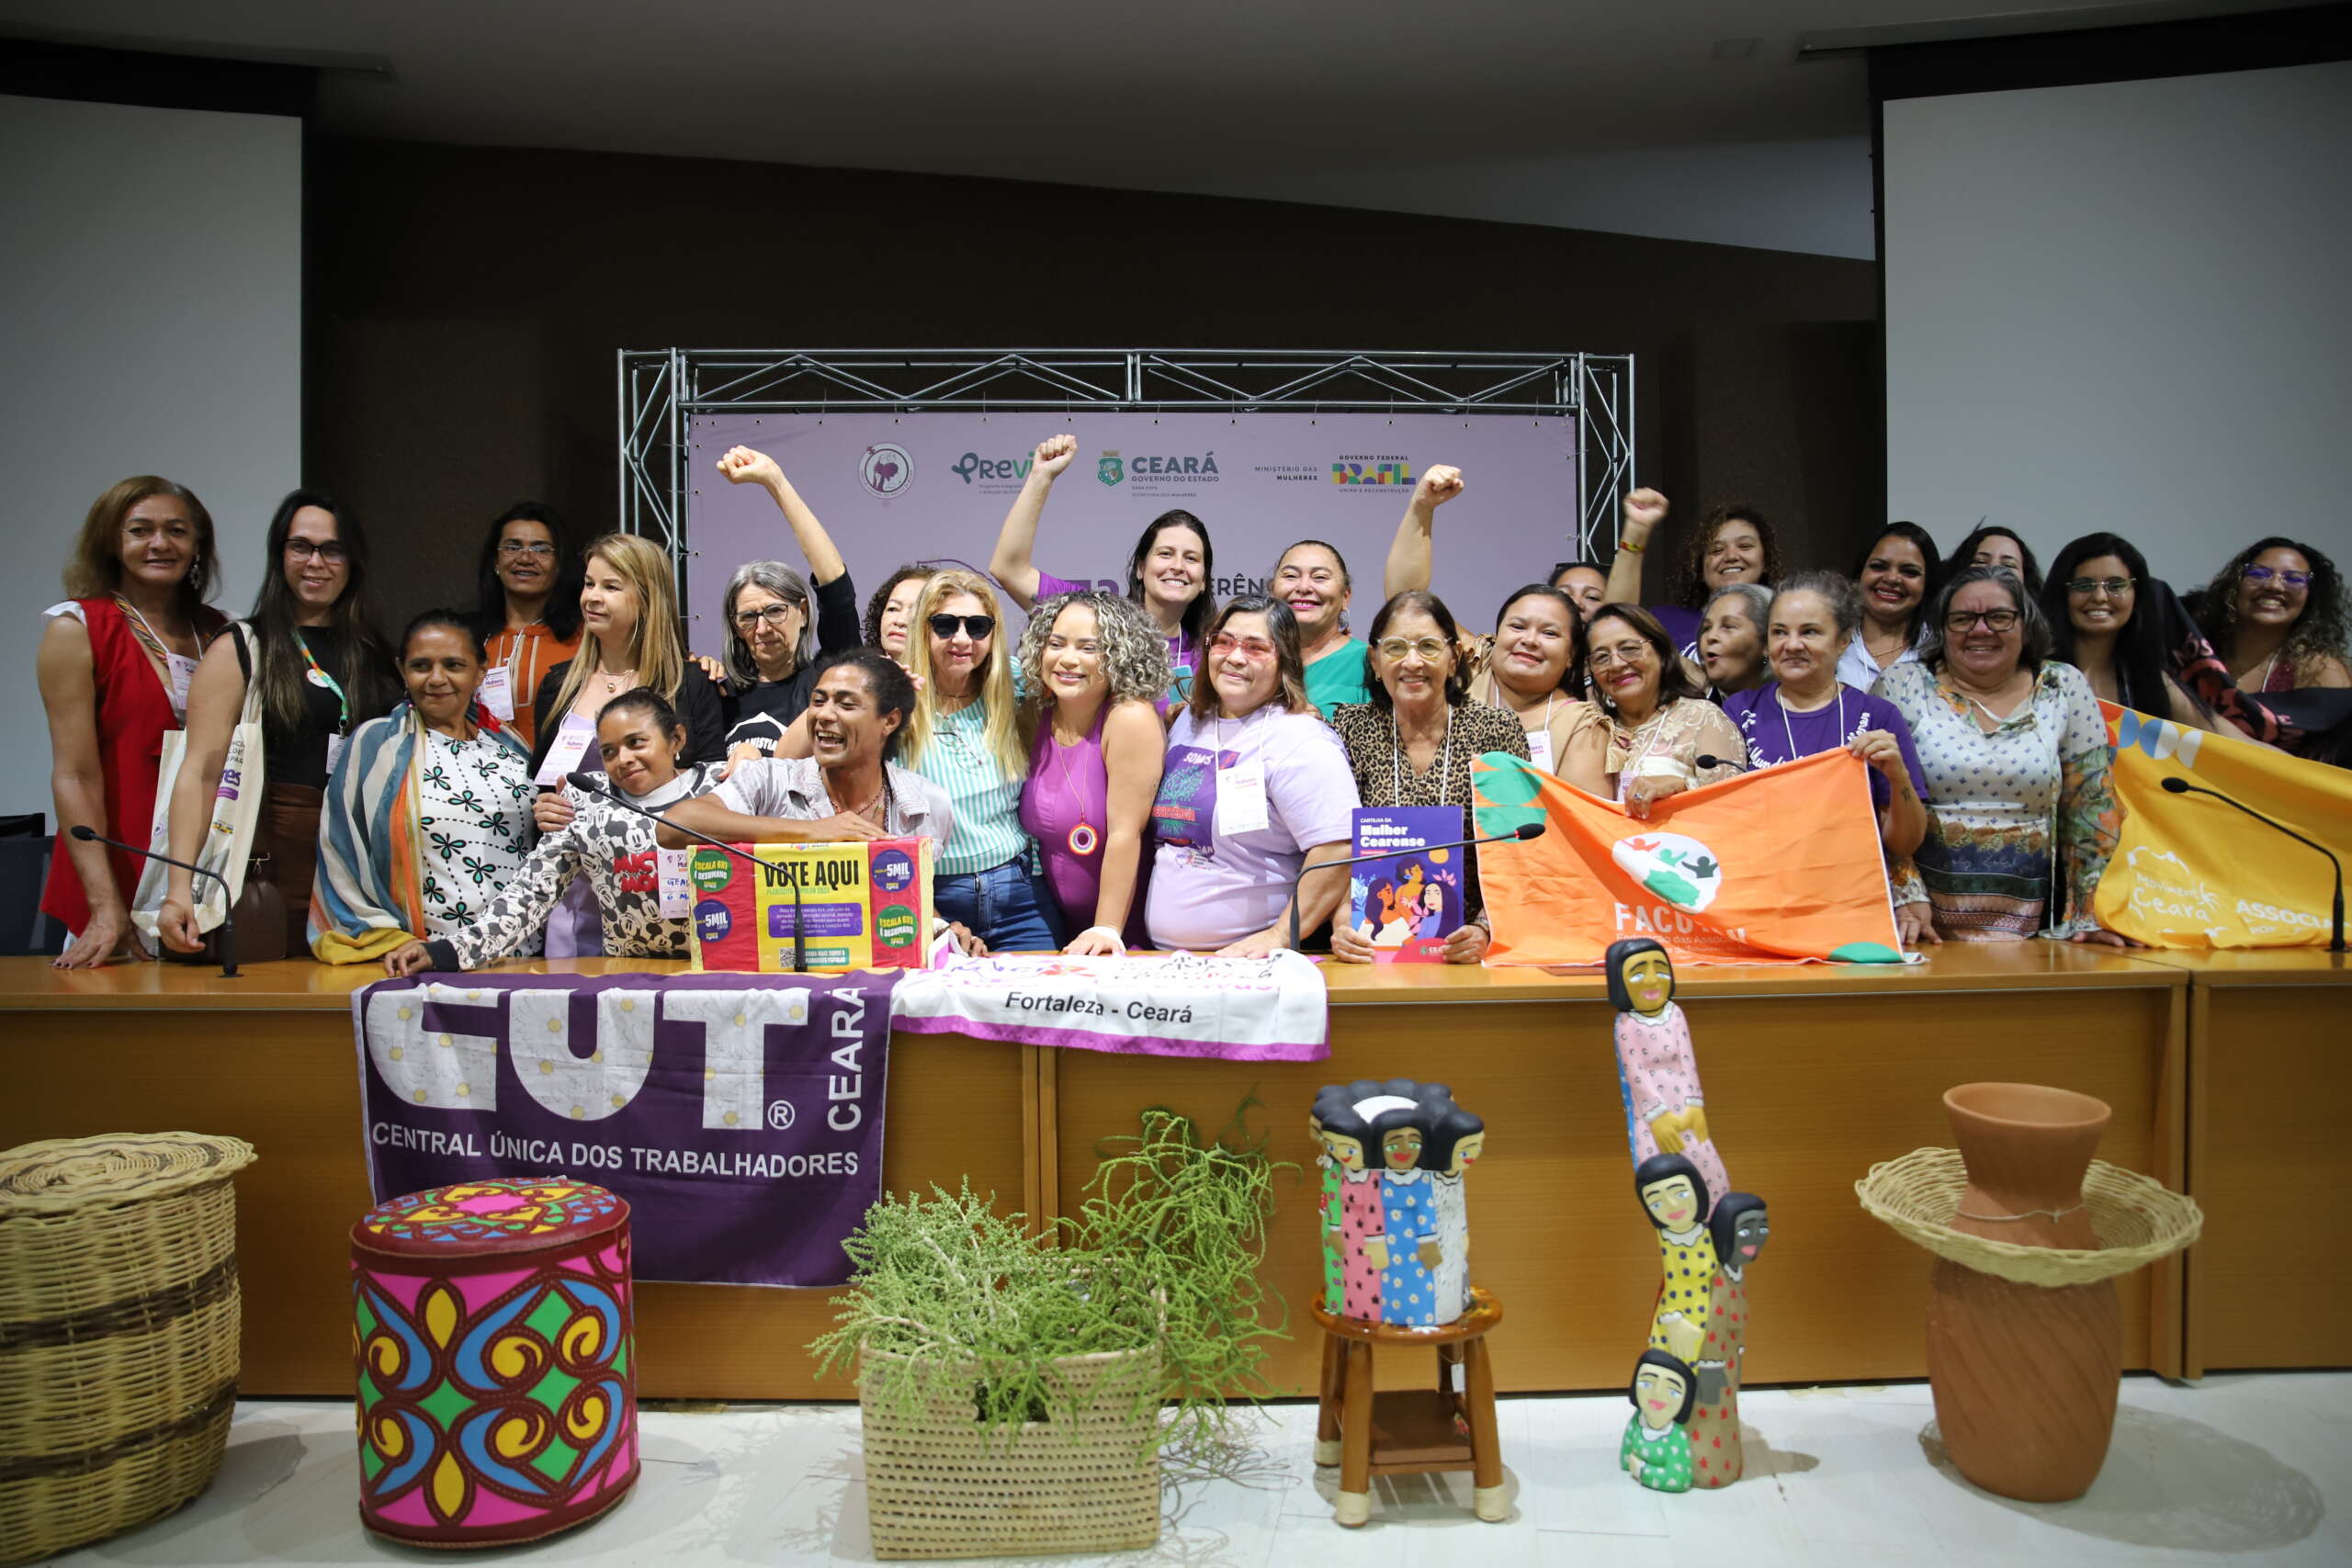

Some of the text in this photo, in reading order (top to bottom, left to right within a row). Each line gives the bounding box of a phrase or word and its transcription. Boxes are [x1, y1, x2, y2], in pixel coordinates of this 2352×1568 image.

[1131, 451, 1219, 474] CEARÁ
[1331, 463, 1417, 485] BRASIL
[1360, 824, 1408, 836] Mulher
[1360, 837, 1426, 848] Cearense
[764, 860, 860, 891] VOTE AQUI
[886, 862, 910, 877] 5MIL
[705, 911, 729, 928] 5MIL
[1004, 991, 1104, 1017] Fortaleza
[1126, 1001, 1193, 1024] Ceará
[367, 981, 811, 1130] CUT
[823, 987, 868, 1132] CEARÁ
[372, 1122, 859, 1178] CENTRAL ÚNICA DOS TRABALHADORES
